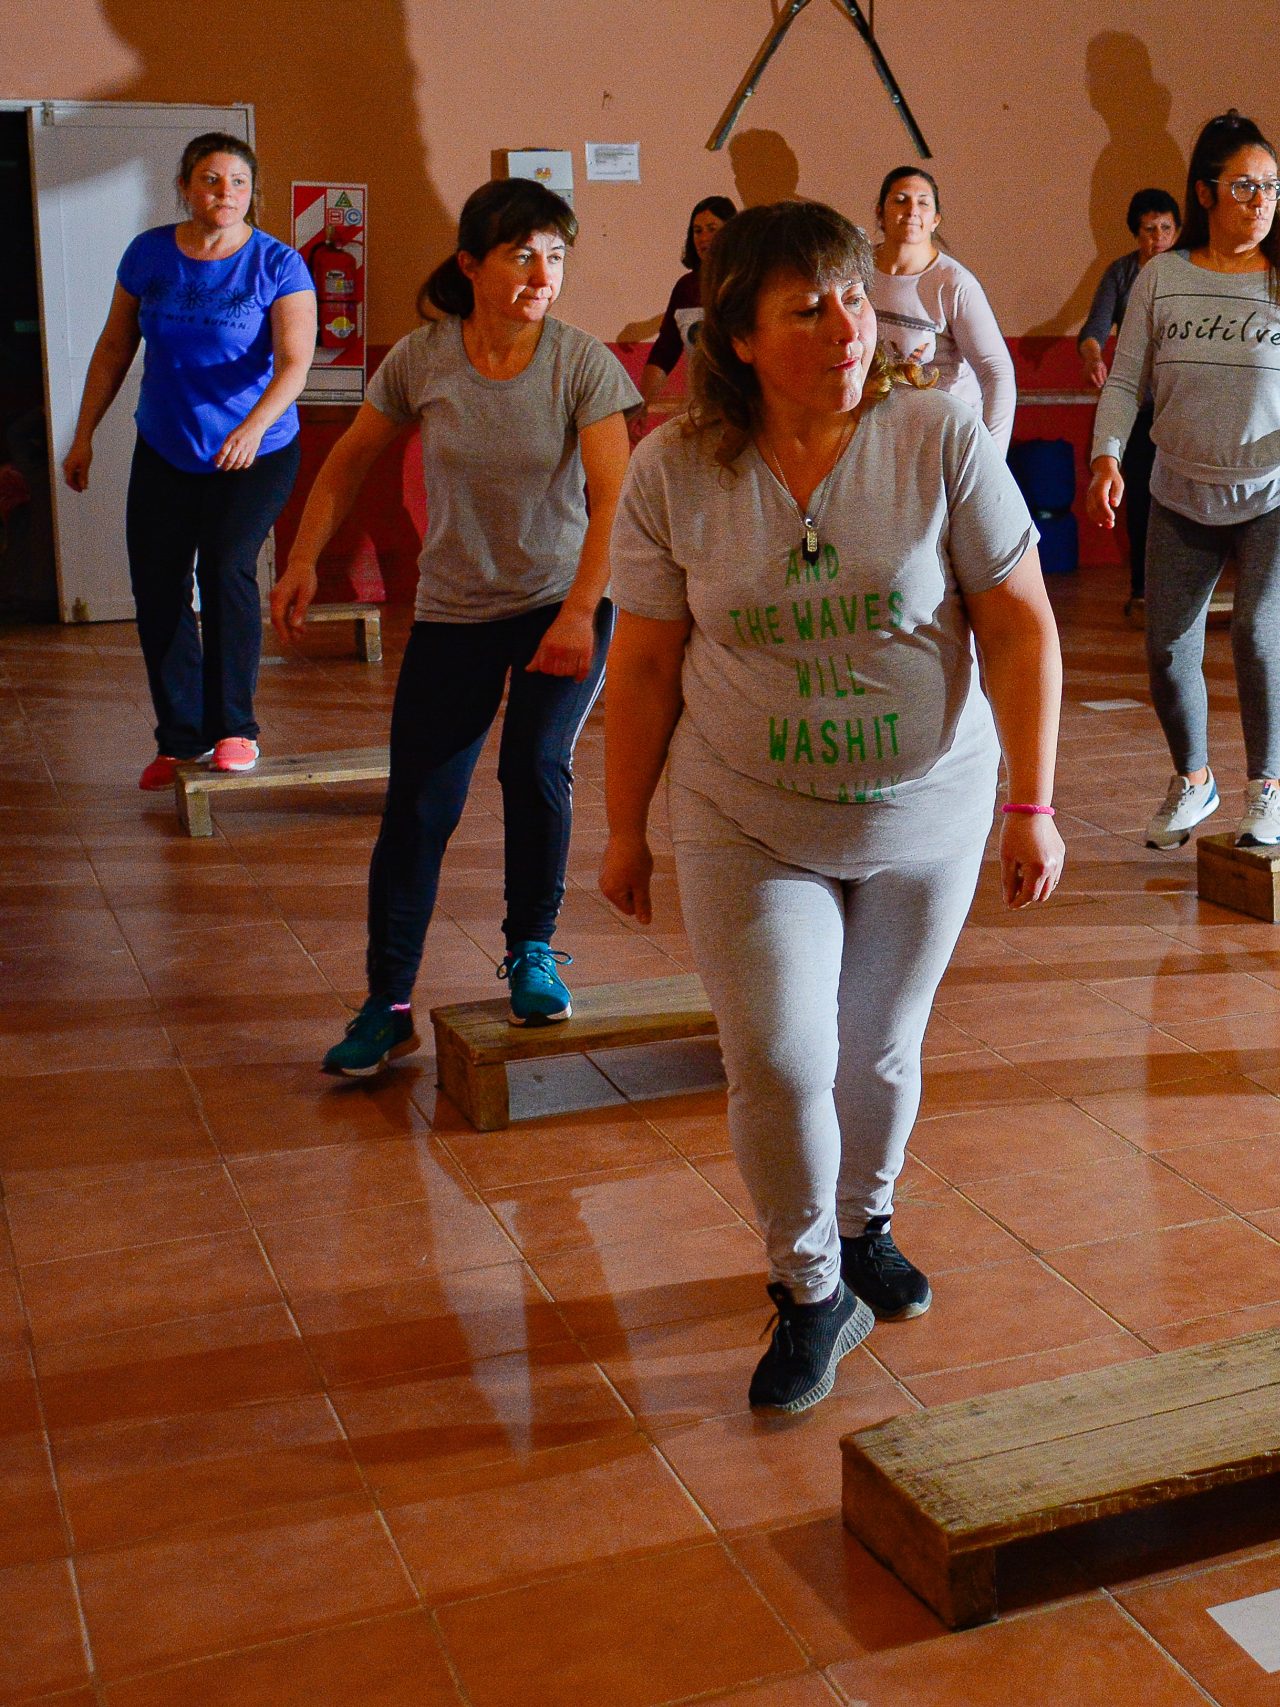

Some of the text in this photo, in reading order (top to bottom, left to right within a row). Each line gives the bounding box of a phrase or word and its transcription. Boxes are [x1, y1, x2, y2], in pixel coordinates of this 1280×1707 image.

[784, 543, 840, 587] AND
[728, 590, 905, 645] THE WAVES
[796, 653, 866, 698] WILL
